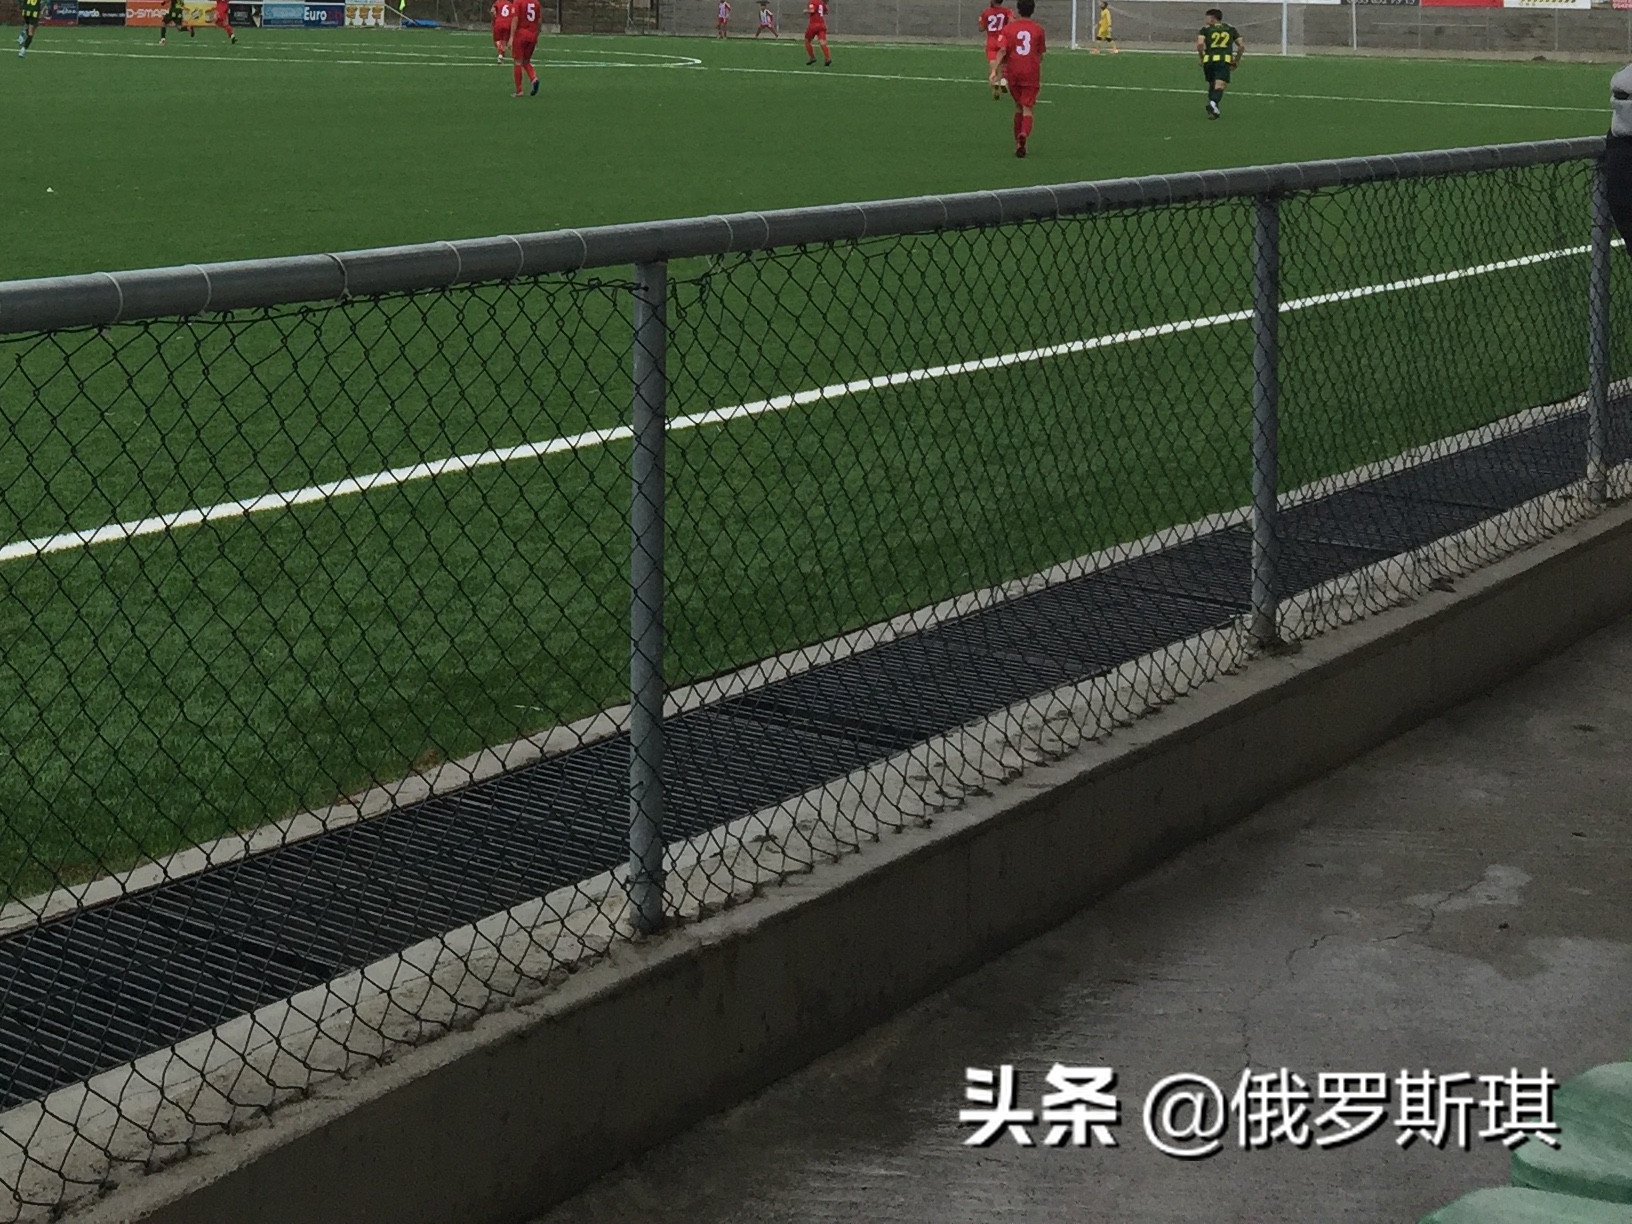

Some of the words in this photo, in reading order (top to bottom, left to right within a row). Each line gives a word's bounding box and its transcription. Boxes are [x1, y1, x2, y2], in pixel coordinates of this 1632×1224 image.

[501, 5, 509, 17] 6
[527, 3, 536, 22] 5
[986, 14, 1006, 32] 27
[1015, 30, 1031, 56] 3
[1210, 31, 1229, 48] 22
